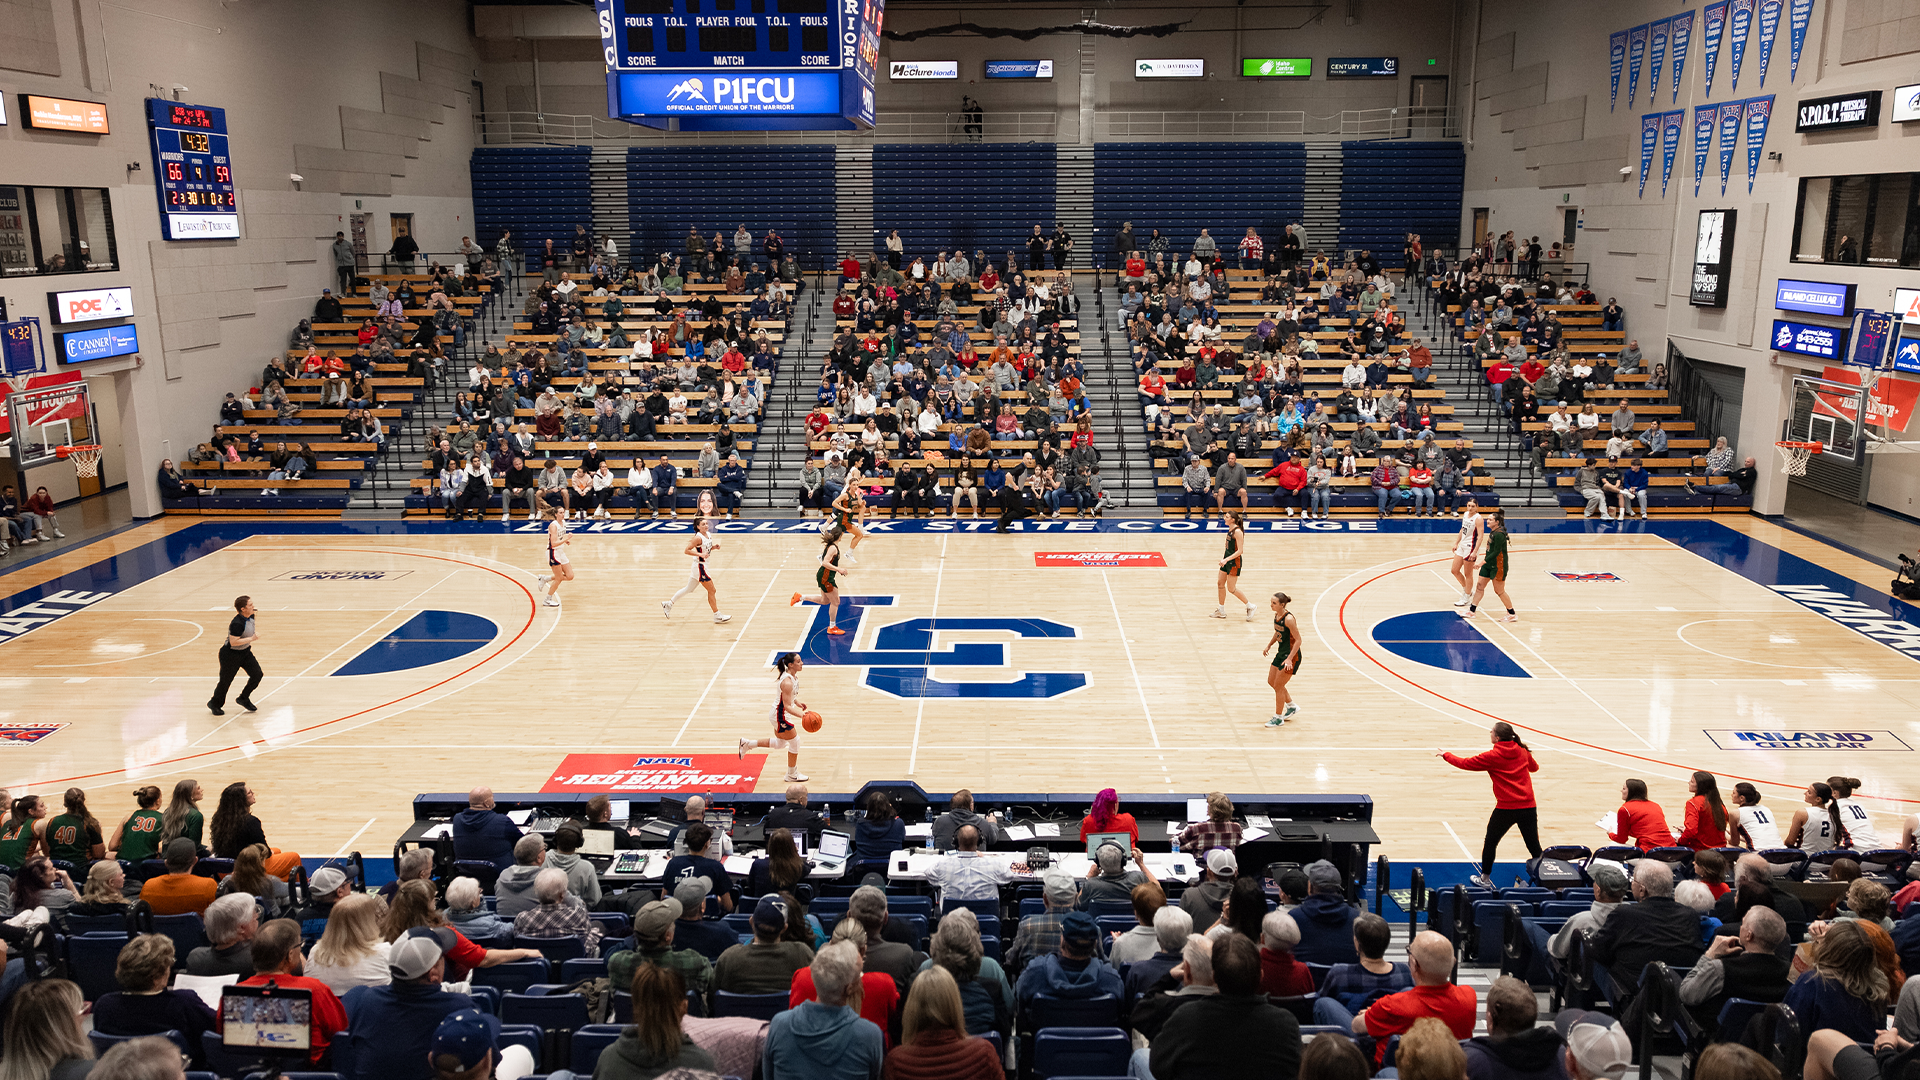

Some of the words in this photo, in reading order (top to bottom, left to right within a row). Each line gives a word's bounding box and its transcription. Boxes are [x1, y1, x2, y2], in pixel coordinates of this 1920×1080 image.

[624, 17, 653, 27] FOULS
[663, 17, 688, 27] T.O.L.
[696, 17, 729, 27] PLAYER
[735, 17, 757, 27] FOUL
[766, 17, 791, 27] T.O.L.
[800, 17, 828, 26] FOULS
[1706, 6, 1725, 25] NAIA
[627, 56, 657, 66] SCORE
[713, 56, 745, 66] MATCH
[801, 55, 830, 65] SCORE
[1732, 44, 1741, 80] 2005
[1760, 42, 1769, 76] 2002
[1748, 100, 1770, 119] NAIA
[1840, 98, 1868, 112] PHYSICAL
[186, 110, 194, 118] vs
[1696, 109, 1715, 126] NAIA
[1721, 104, 1741, 123] NAIA
[1799, 102, 1840, 127] S.P.O.R.T.
[1840, 109, 1866, 122] THERAPY
[183, 116, 191, 125] 24
[197, 118, 202, 127] 5
[186, 134, 209, 152] 4:32
[161, 151, 184, 162] WARRIORS
[213, 155, 226, 164] GUEST
[168, 162, 183, 181] 66
[195, 167, 202, 179] 4
[216, 166, 230, 183] 59
[1695, 156, 1703, 187] 2016
[172, 191, 178, 205] 2
[180, 193, 186, 203] 3
[186, 191, 198, 205] 30
[218, 194, 223, 204] 2
[228, 192, 234, 206] 2
[178, 221, 208, 232] LEWISTON
[208, 221, 232, 232] TRIBUNE
[1696, 265, 1707, 274] THE
[1695, 274, 1718, 284] DIAMOND
[1702, 282, 1718, 293] SHOP
[1783, 291, 1807, 302] INLAND
[1806, 294, 1837, 305] CELLULAR
[8, 325, 30, 340] 4:32
[78, 336, 110, 351] CANNER
[714, 521, 898, 532] CLAK
[922, 521, 1098, 531] STATE
[1117, 520, 1380, 531] COLLEGE
[1734, 732, 1874, 742] INLAND
[633, 757, 693, 767] NAIA
[562, 774, 625, 785] RED
[621, 774, 743, 785] BANNER
[1753, 810, 1770, 824] 11
[1848, 805, 1868, 820] 10
[131, 815, 156, 833] 30
[1820, 820, 1831, 838] 2
[54, 825, 77, 845] 40
